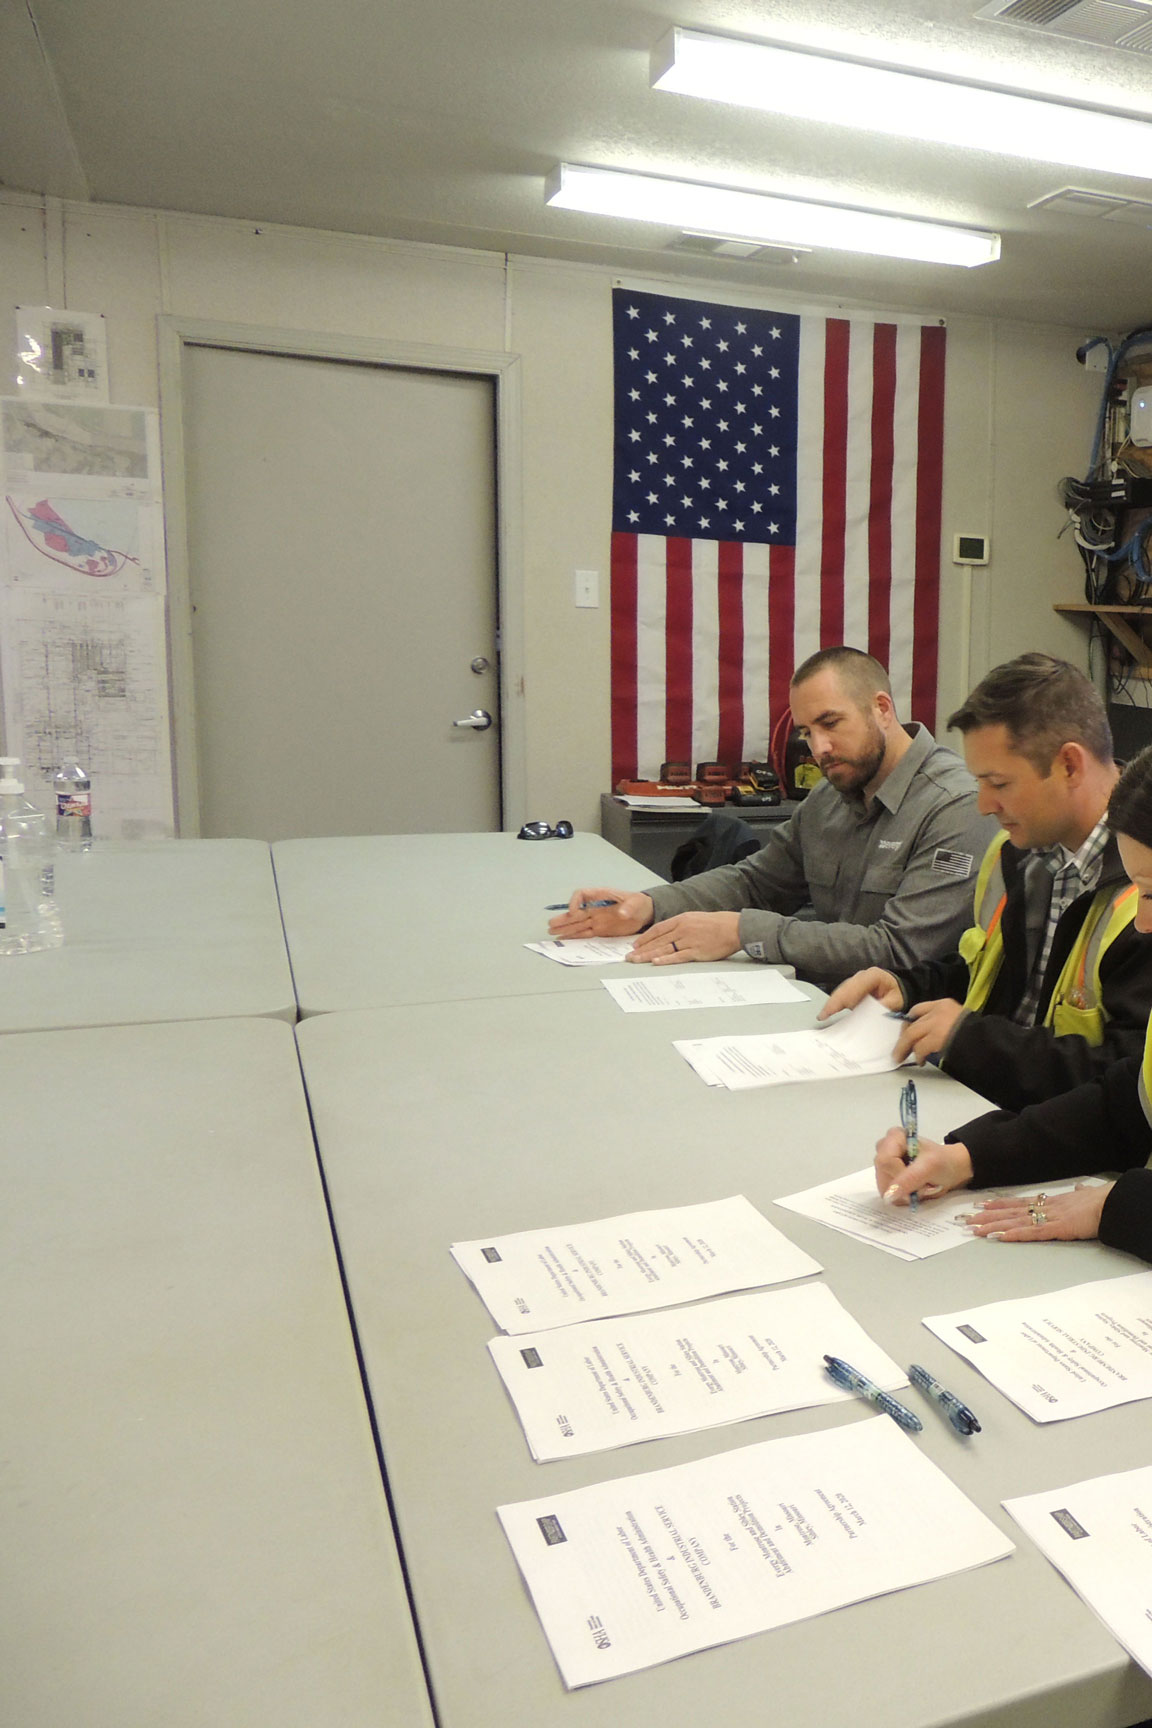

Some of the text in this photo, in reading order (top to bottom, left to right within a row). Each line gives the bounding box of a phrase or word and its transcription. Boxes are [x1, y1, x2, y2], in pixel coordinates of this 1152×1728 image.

[744, 1526, 757, 1536] and
[720, 1532, 739, 1551] For the
[762, 1537, 775, 1547] and
[590, 1628, 611, 1650] OSHA
